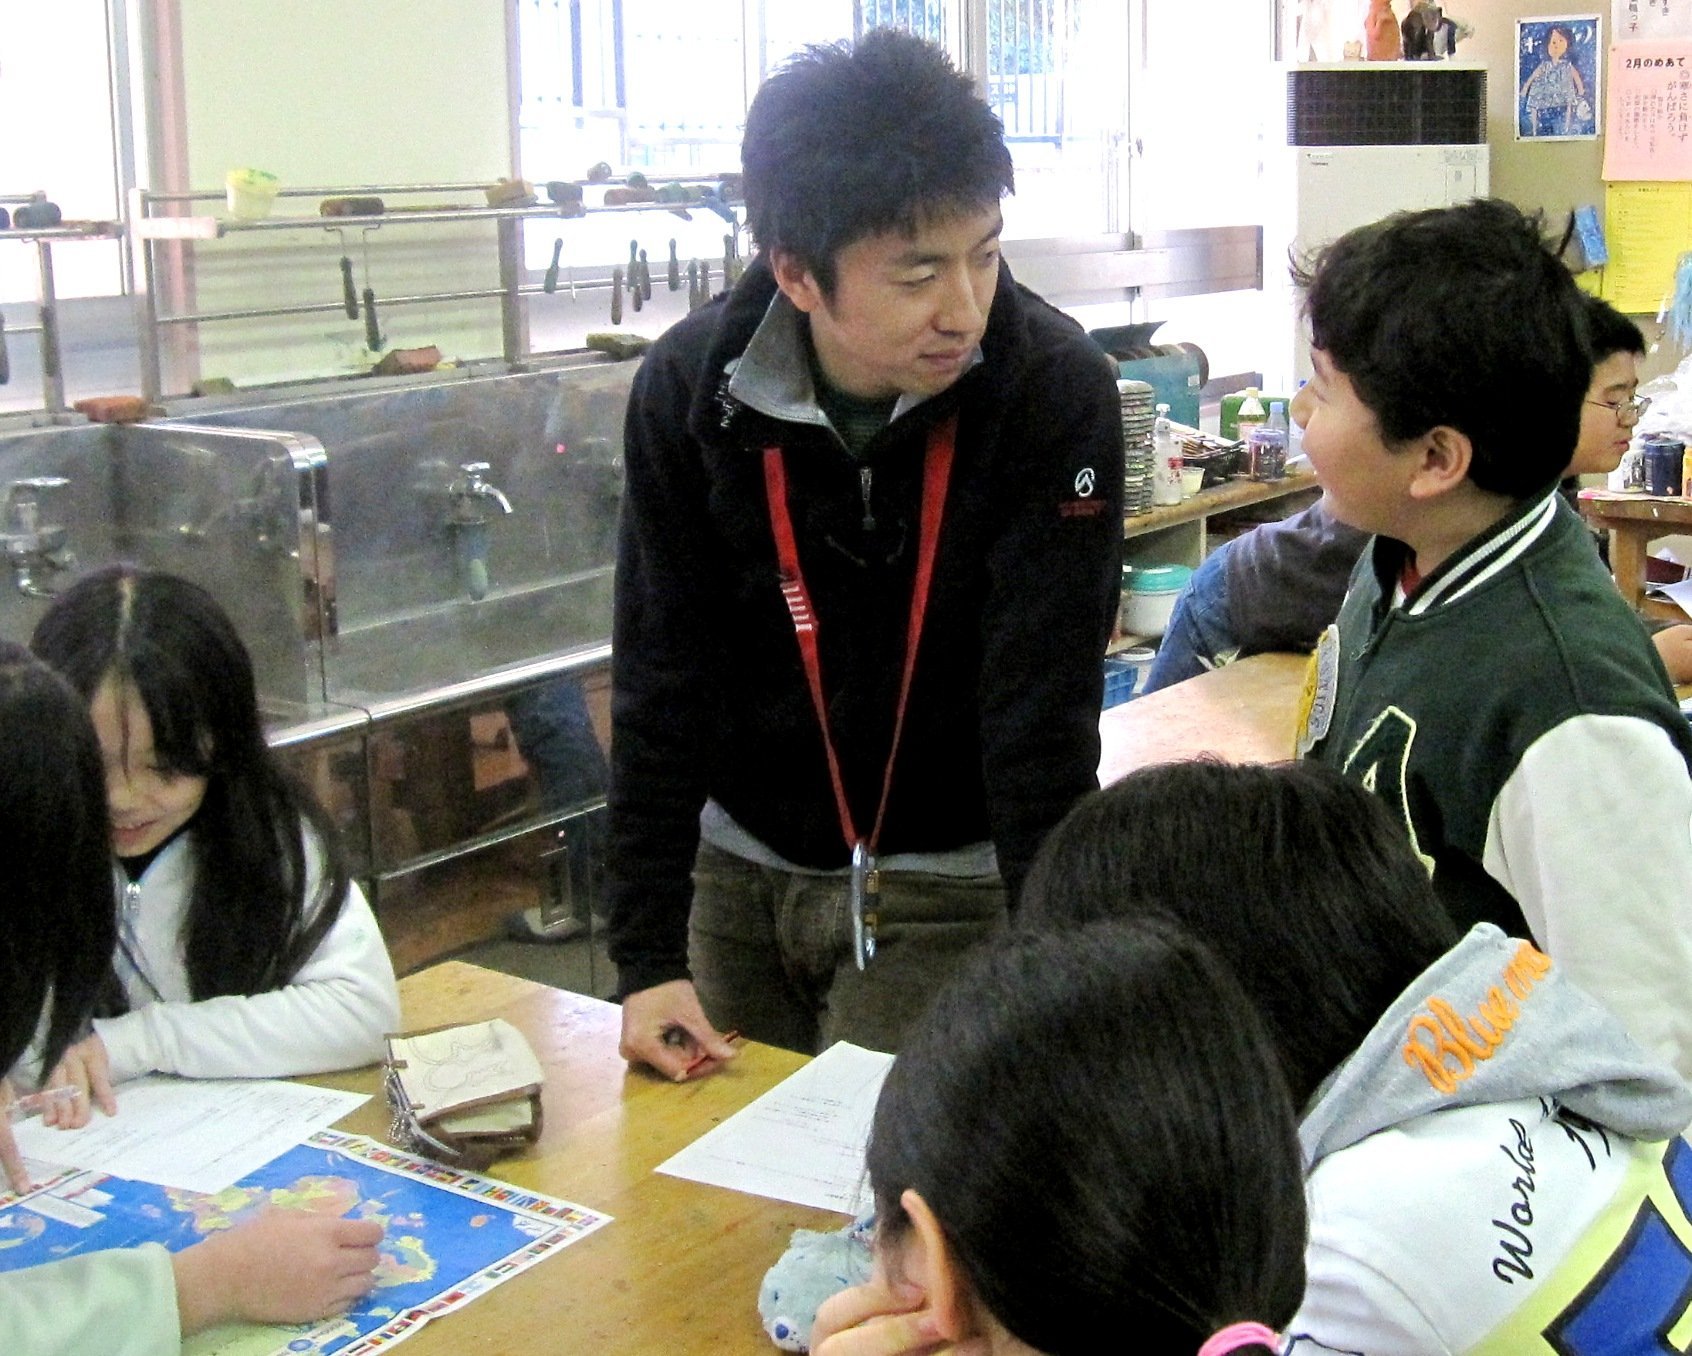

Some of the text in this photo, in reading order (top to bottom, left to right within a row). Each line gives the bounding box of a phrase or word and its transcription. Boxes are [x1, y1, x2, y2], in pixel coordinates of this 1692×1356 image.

[1626, 57, 1685, 69] 2月のめあて
[1492, 1117, 1536, 1285] World
